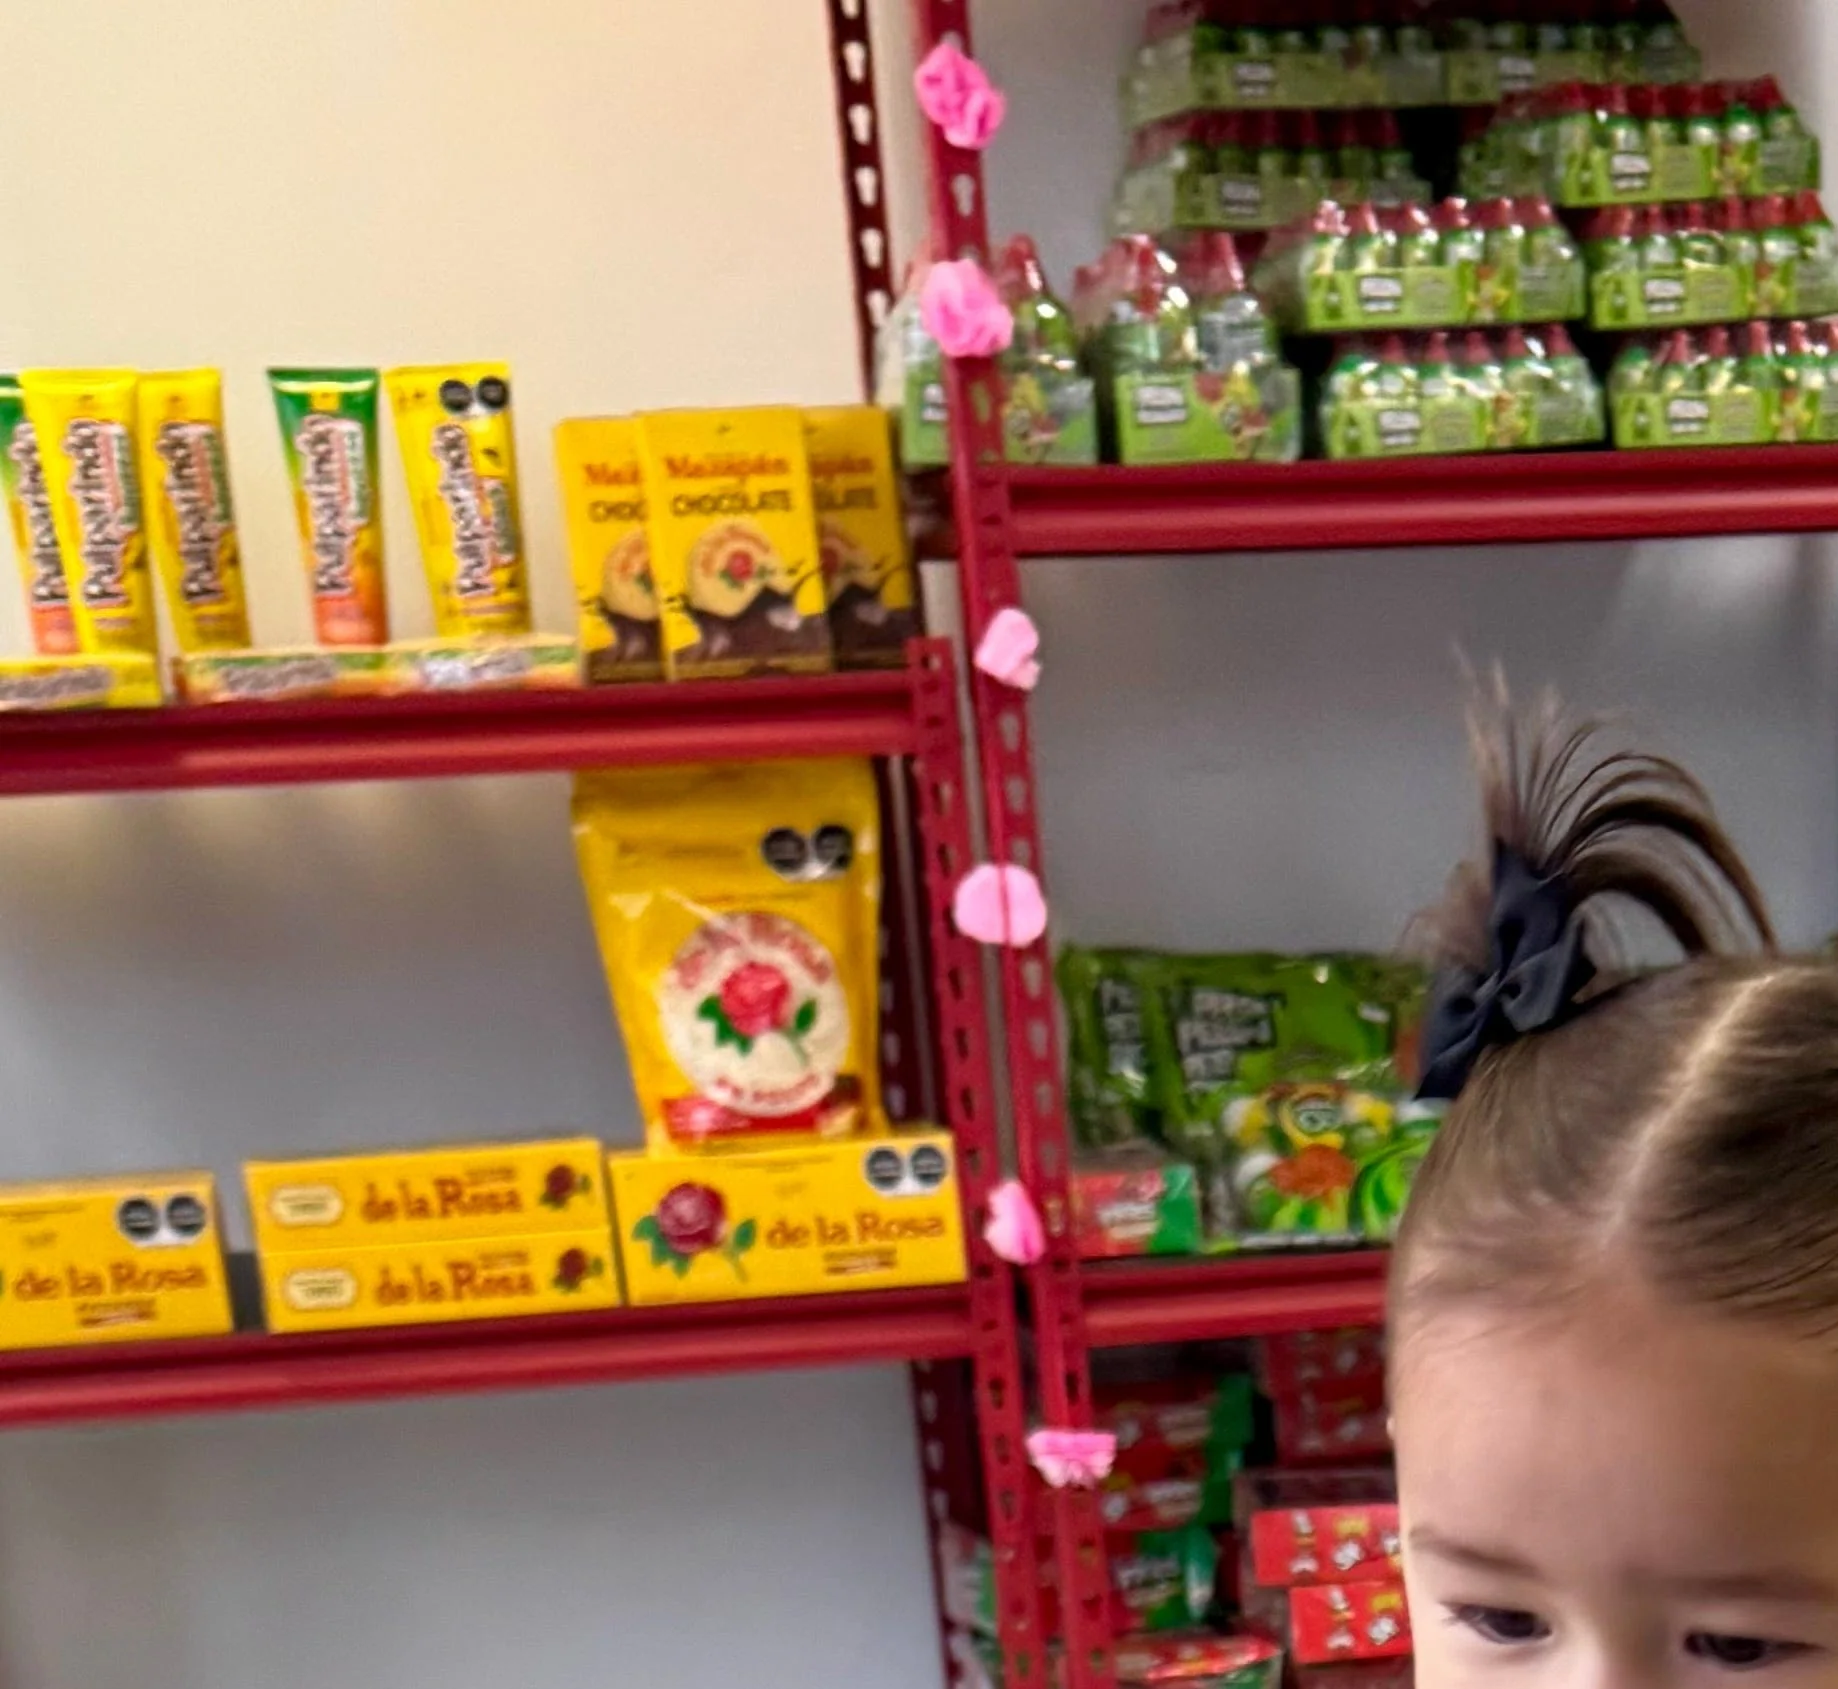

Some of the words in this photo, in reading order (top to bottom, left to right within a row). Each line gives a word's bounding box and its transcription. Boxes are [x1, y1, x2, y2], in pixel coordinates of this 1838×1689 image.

[63, 418, 127, 604] Pulparindo
[155, 421, 222, 602] Pulparindo
[295, 414, 350, 595] Pulparindo
[431, 423, 493, 596] Pulparindo
[673, 490, 791, 517] CHOCOLATE
[435, 1177, 523, 1219] Rosa
[766, 1219, 811, 1249] de
[814, 1213, 850, 1246] la
[857, 1210, 946, 1244] Rosa
[110, 1258, 208, 1294] Rosa
[446, 1261, 537, 1302] Rosa
